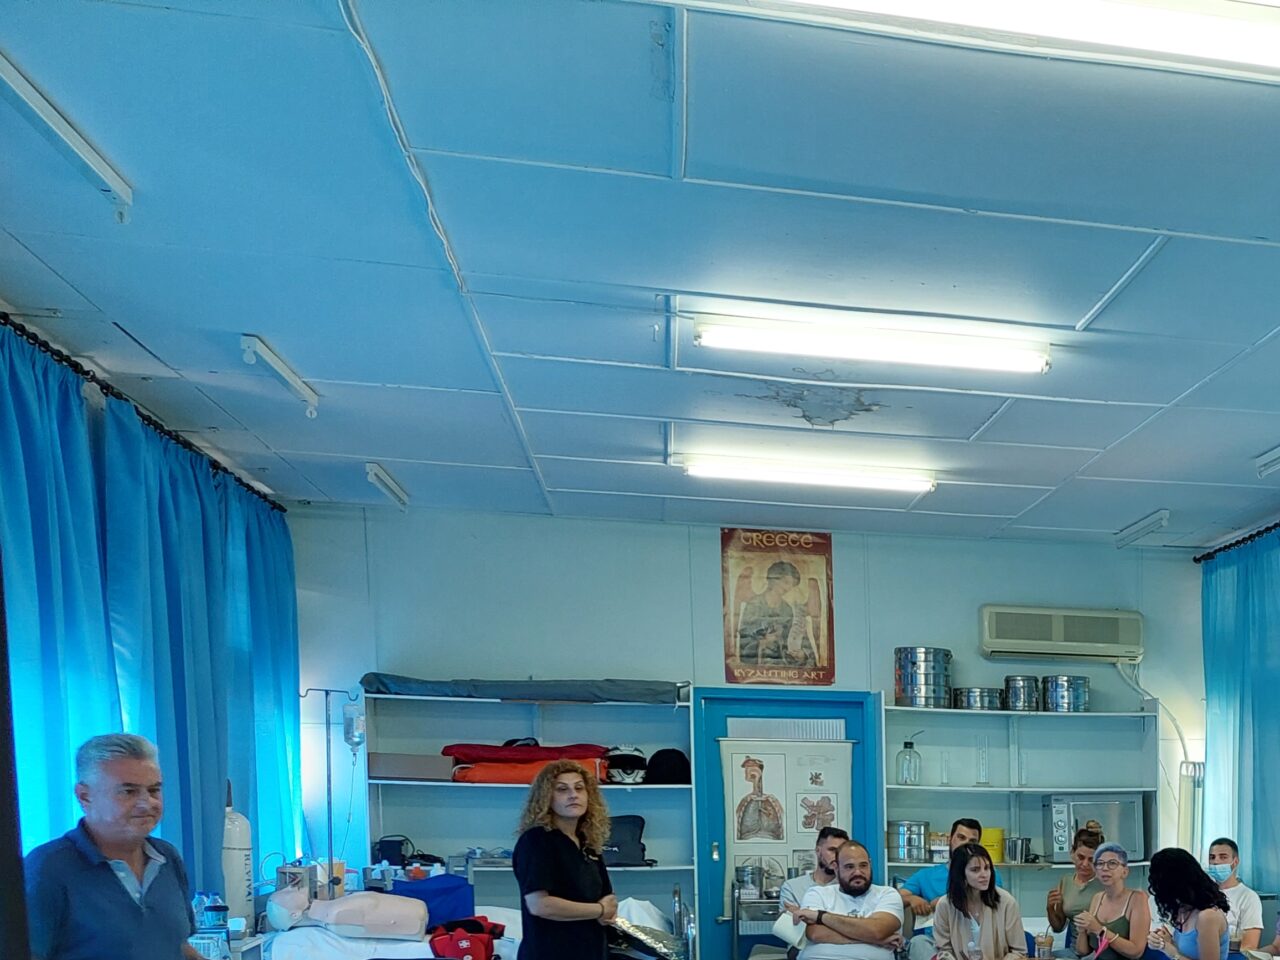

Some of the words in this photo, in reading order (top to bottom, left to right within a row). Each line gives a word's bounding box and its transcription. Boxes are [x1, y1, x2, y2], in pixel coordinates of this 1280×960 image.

[741, 531, 813, 548] GREECE
[734, 668, 799, 679] BYZANTINE
[802, 671, 826, 680] ART
